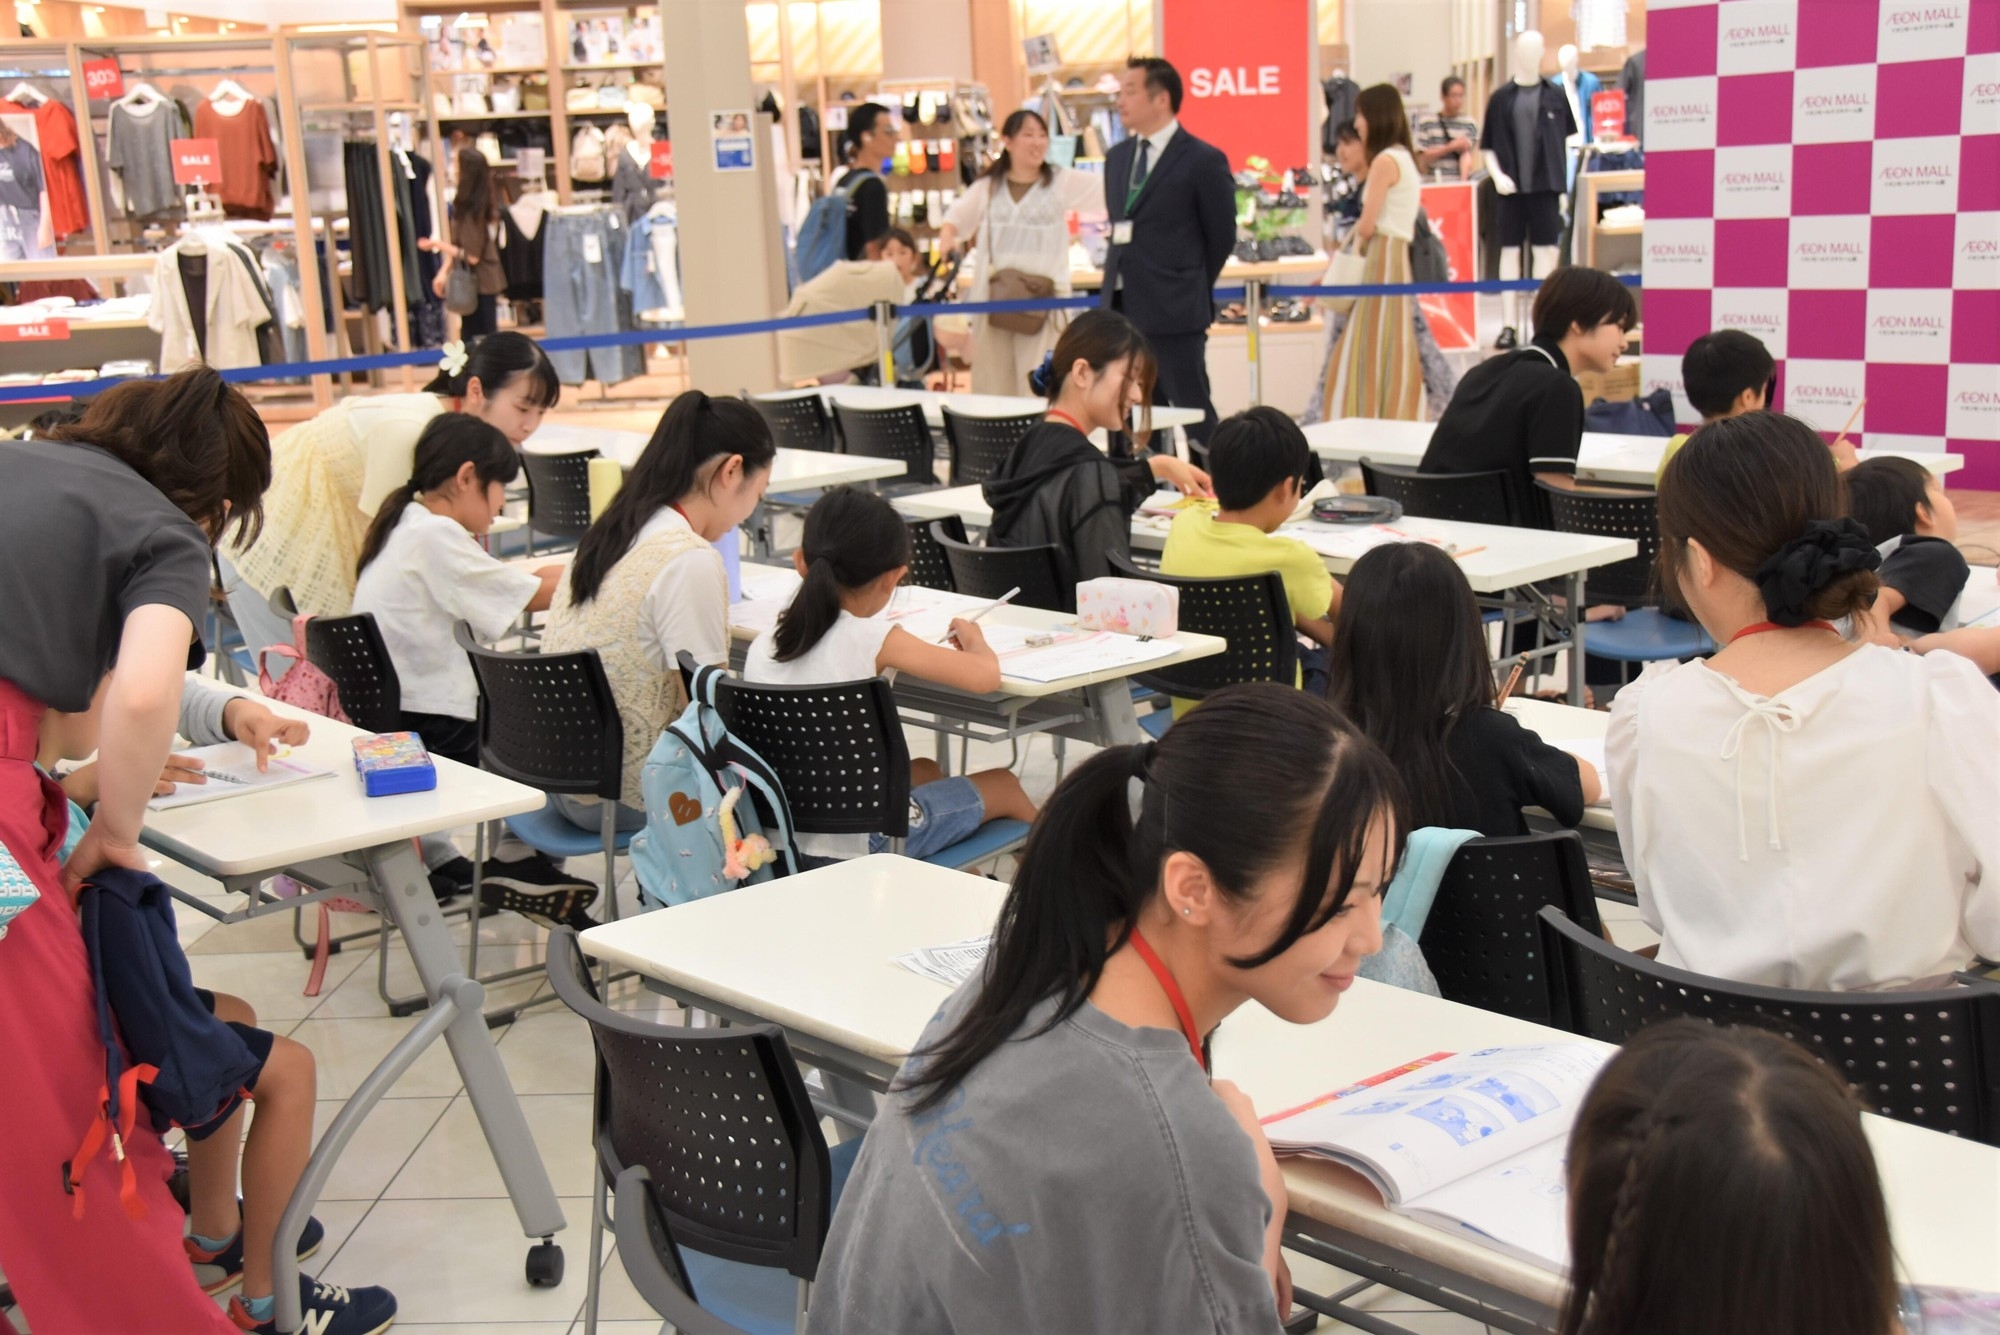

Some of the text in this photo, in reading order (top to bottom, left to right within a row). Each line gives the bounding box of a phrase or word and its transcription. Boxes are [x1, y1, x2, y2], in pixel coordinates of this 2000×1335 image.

[1924, 6, 1962, 21] MALL
[1758, 24, 1791, 36] MALL
[1190, 65, 1281, 98] SALE
[1835, 92, 1870, 106] MALL
[1681, 103, 1711, 116] MALL
[180, 154, 211, 166] SALE
[1753, 171, 1786, 184] MALL
[1916, 164, 1952, 178] MALL
[1678, 244, 1708, 257] MALL
[1829, 242, 1864, 255] MALL
[1750, 314, 1782, 327] MALL
[1909, 316, 1945, 329] MALL
[18, 325, 50, 337] SALE
[1825, 386, 1858, 399] MALL
